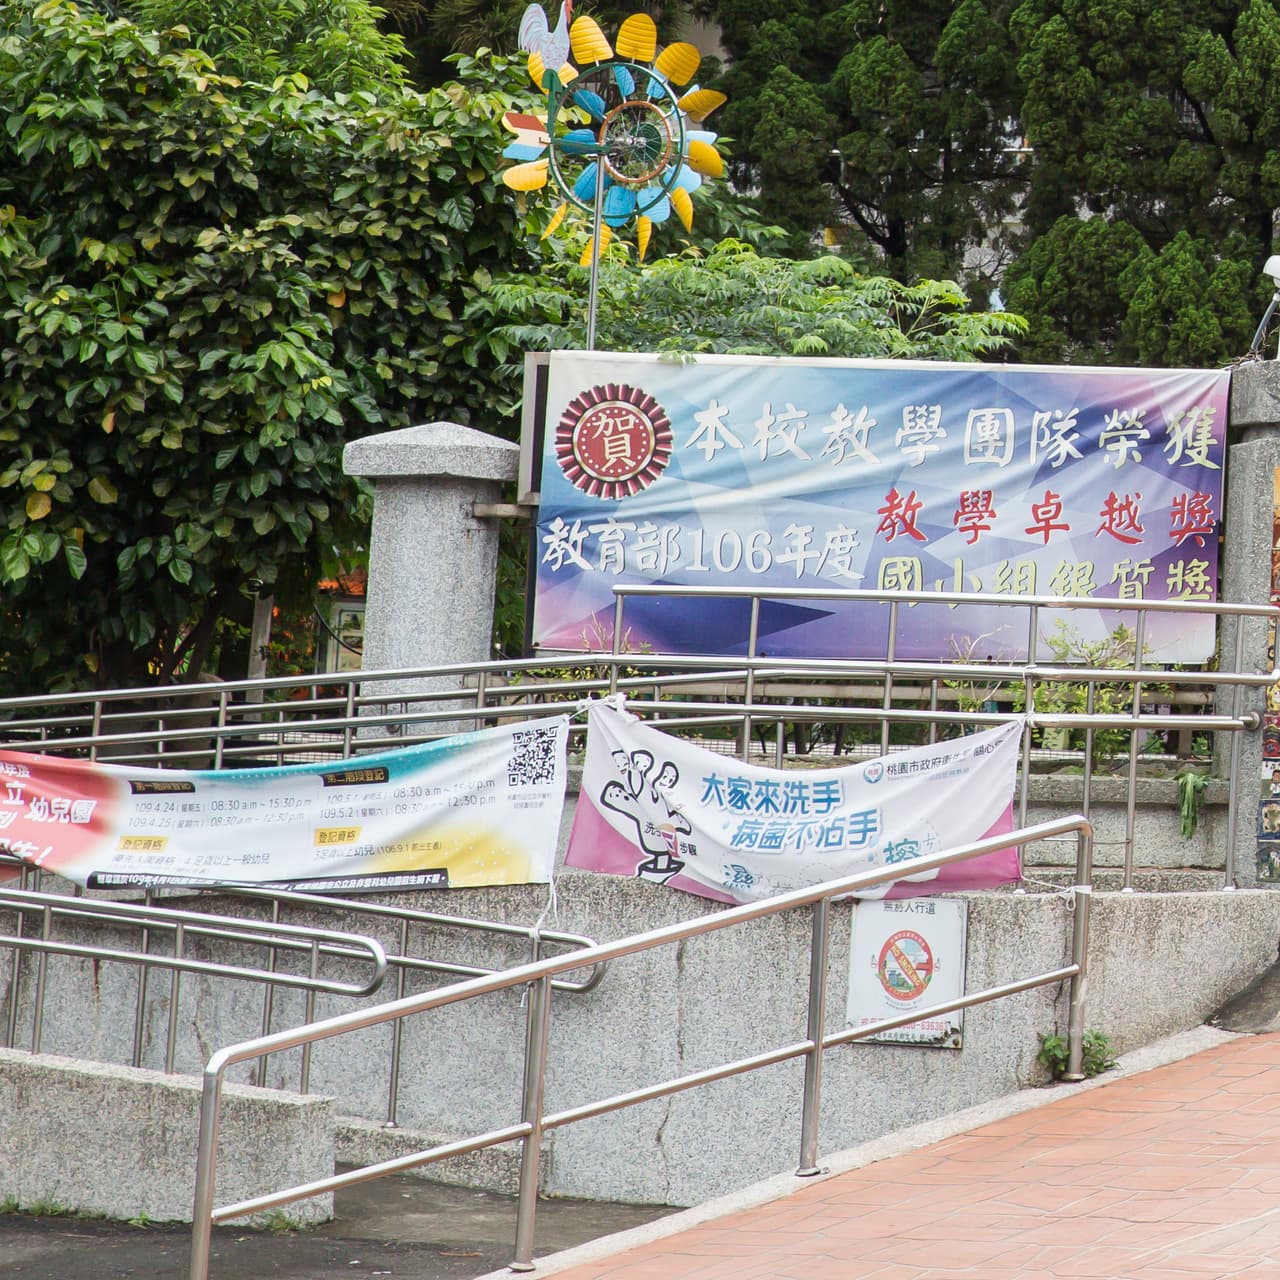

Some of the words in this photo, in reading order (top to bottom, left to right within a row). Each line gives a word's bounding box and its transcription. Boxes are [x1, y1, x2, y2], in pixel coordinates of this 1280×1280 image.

[592, 414, 638, 469] 賀
[684, 399, 1222, 470] 本校教學團隊榮獲
[876, 487, 1215, 548] 教學卓越獎
[540, 518, 865, 581] 教育部106年度
[701, 773, 841, 815] 大家來洗手
[731, 808, 878, 850] 病菌不沾手
